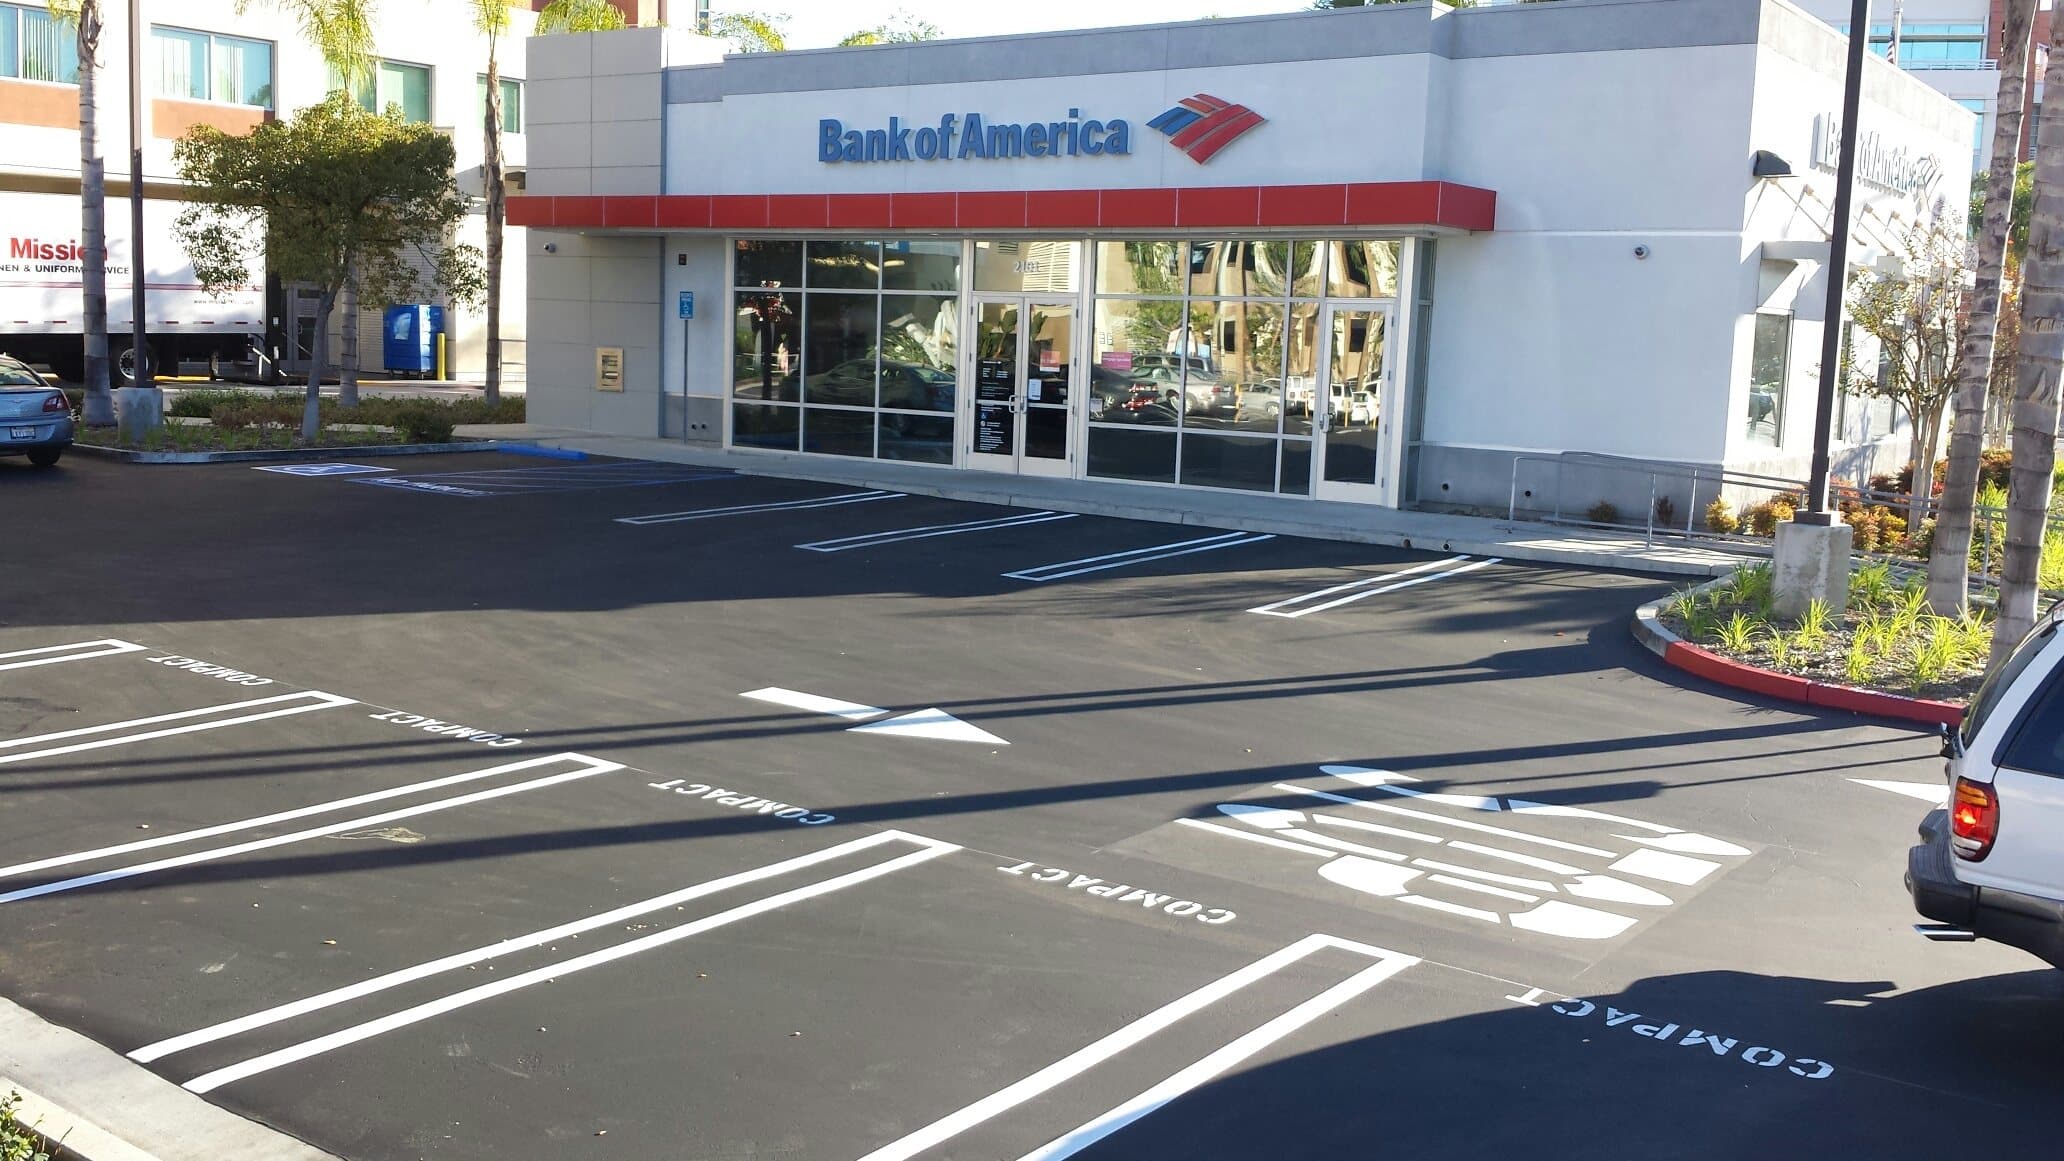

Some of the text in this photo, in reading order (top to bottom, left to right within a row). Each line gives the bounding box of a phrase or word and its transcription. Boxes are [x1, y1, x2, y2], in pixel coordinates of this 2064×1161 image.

[819, 107, 1130, 162] Bank of America
[10, 237, 107, 261] Missi
[146, 654, 273, 686] COMPACT
[368, 711, 523, 747] COMPACT
[648, 779, 835, 824] COMPACT
[997, 861, 1237, 924] COMPACT
[1505, 987, 1834, 1079] COMPACT
